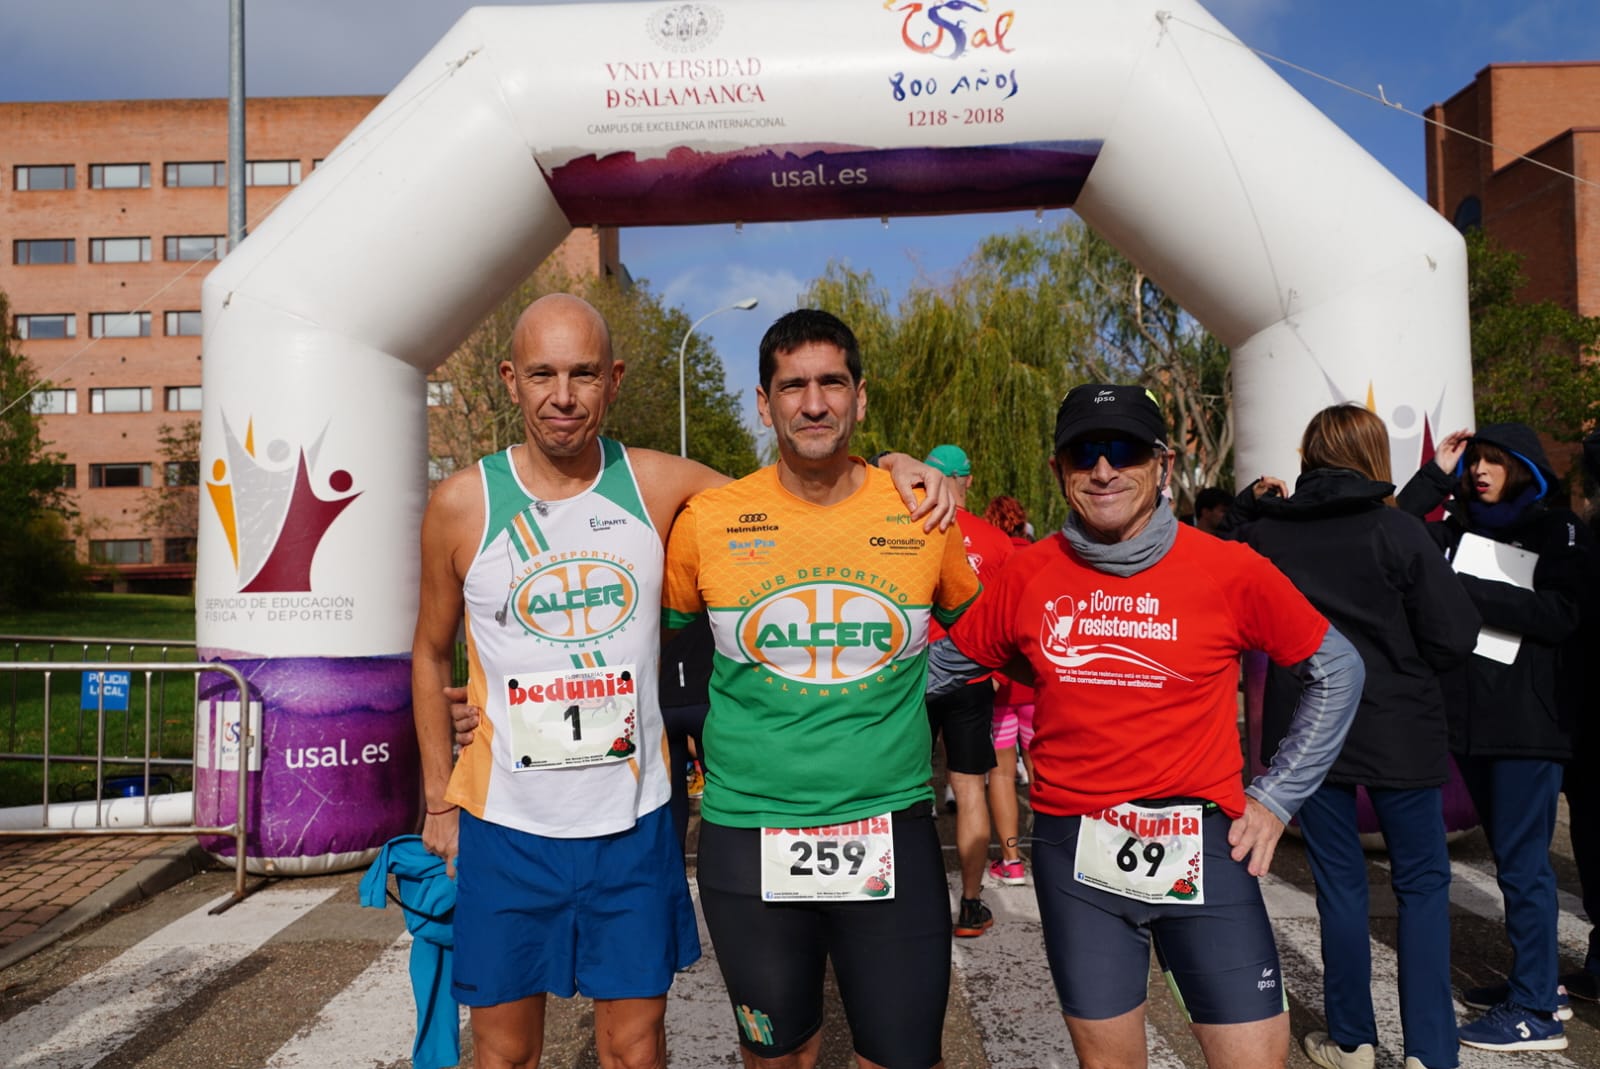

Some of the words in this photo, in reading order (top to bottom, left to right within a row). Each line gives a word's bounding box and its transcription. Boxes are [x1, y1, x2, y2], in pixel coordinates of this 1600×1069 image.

[888, 71, 937, 102] 800
[950, 69, 1019, 101] AÑOS
[586, 122, 630, 135] CAMPUS
[631, 122, 645, 133] DE
[646, 120, 705, 132] EXCELENCIA
[707, 117, 787, 129] INTERNACIONAL
[771, 164, 868, 188] usal.es
[509, 560, 543, 589] CLUB
[549, 550, 635, 571] DEPORTIVO
[527, 583, 627, 616] ALCER
[738, 574, 787, 606] CLUB
[797, 566, 909, 604] DEPORTIVO
[204, 597, 248, 610] SERVICIO
[250, 597, 268, 609] DE
[247, 611, 256, 621] Y
[267, 609, 354, 621] DEPORTES
[1135, 592, 1160, 616] sin
[754, 621, 893, 653] ALCER
[1077, 613, 1178, 642] resistencias!
[752, 664, 899, 697] SALAMANCA
[563, 705, 582, 741] 1
[285, 738, 390, 769] usal.es
[789, 840, 866, 876] 259
[1116, 837, 1165, 877] 69
